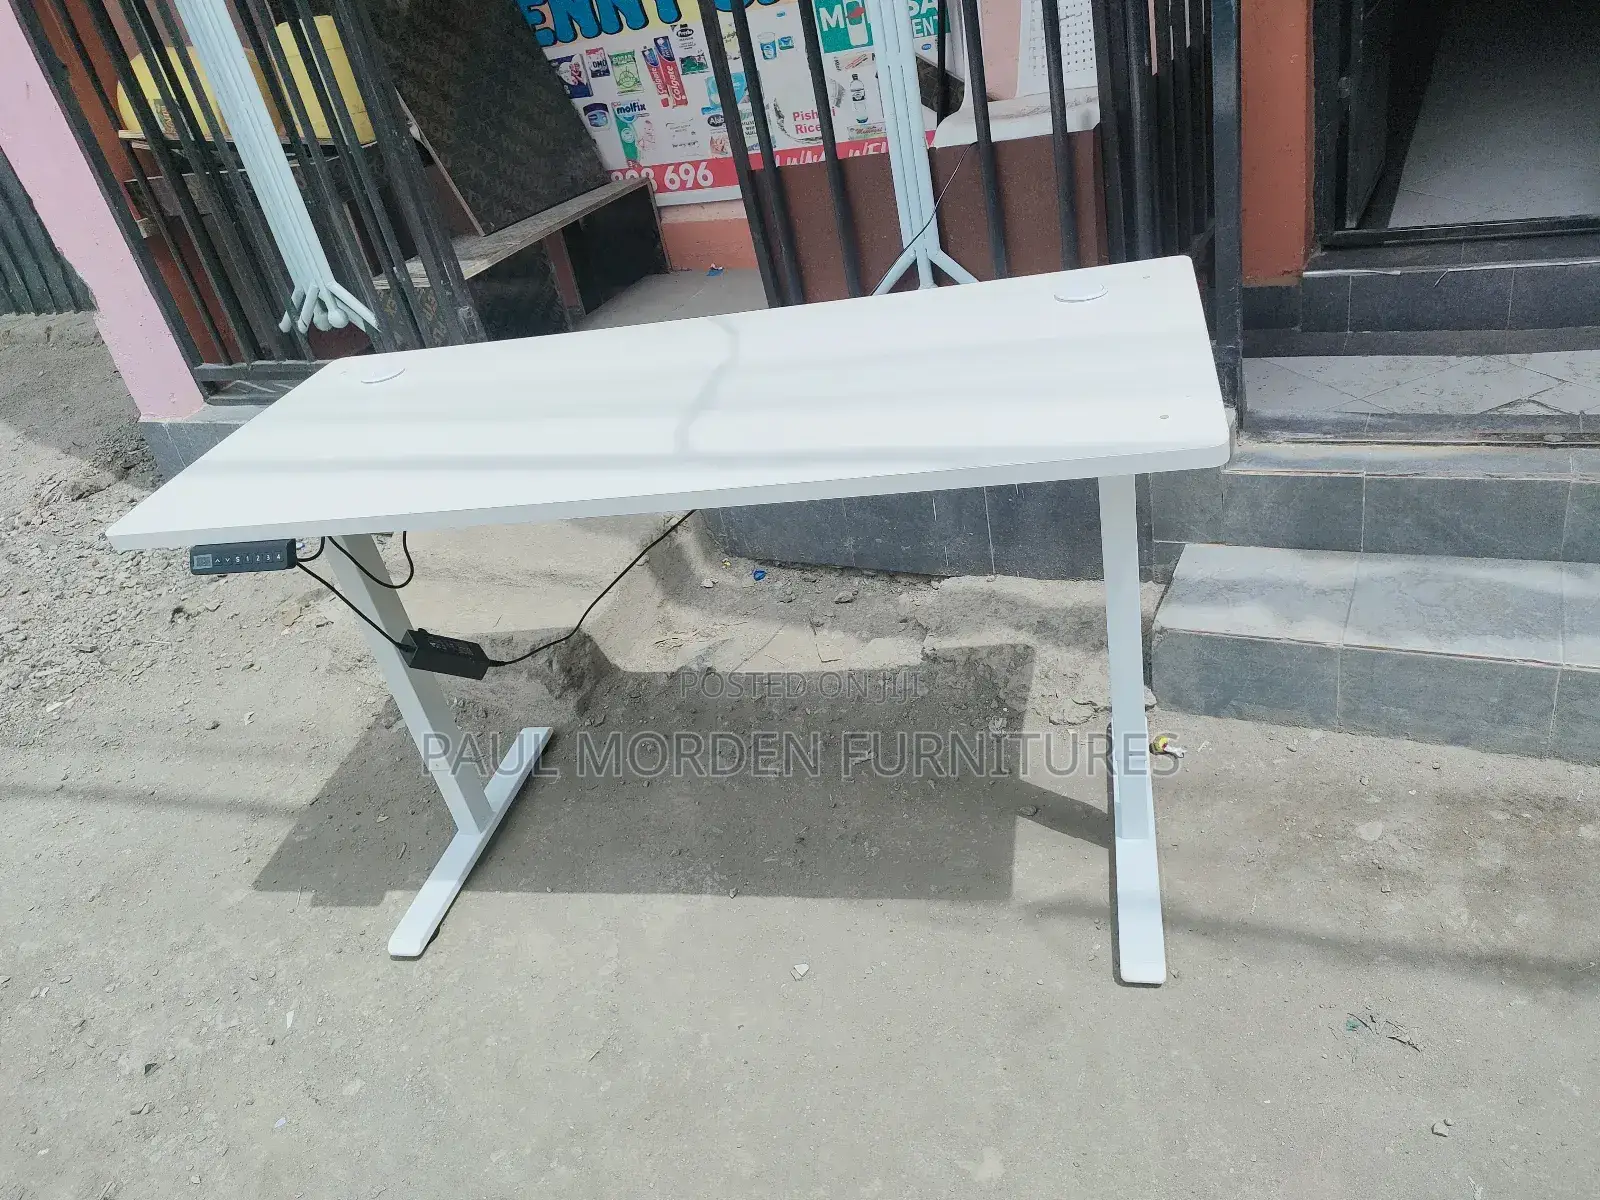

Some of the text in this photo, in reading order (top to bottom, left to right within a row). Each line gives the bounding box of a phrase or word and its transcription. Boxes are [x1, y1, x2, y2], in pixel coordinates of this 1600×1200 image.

[666, 64, 682, 101] Colgate
[616, 102, 647, 115] molfix
[792, 106, 836, 121] Pishi
[795, 122, 821, 135] Rice
[663, 161, 714, 191] 696
